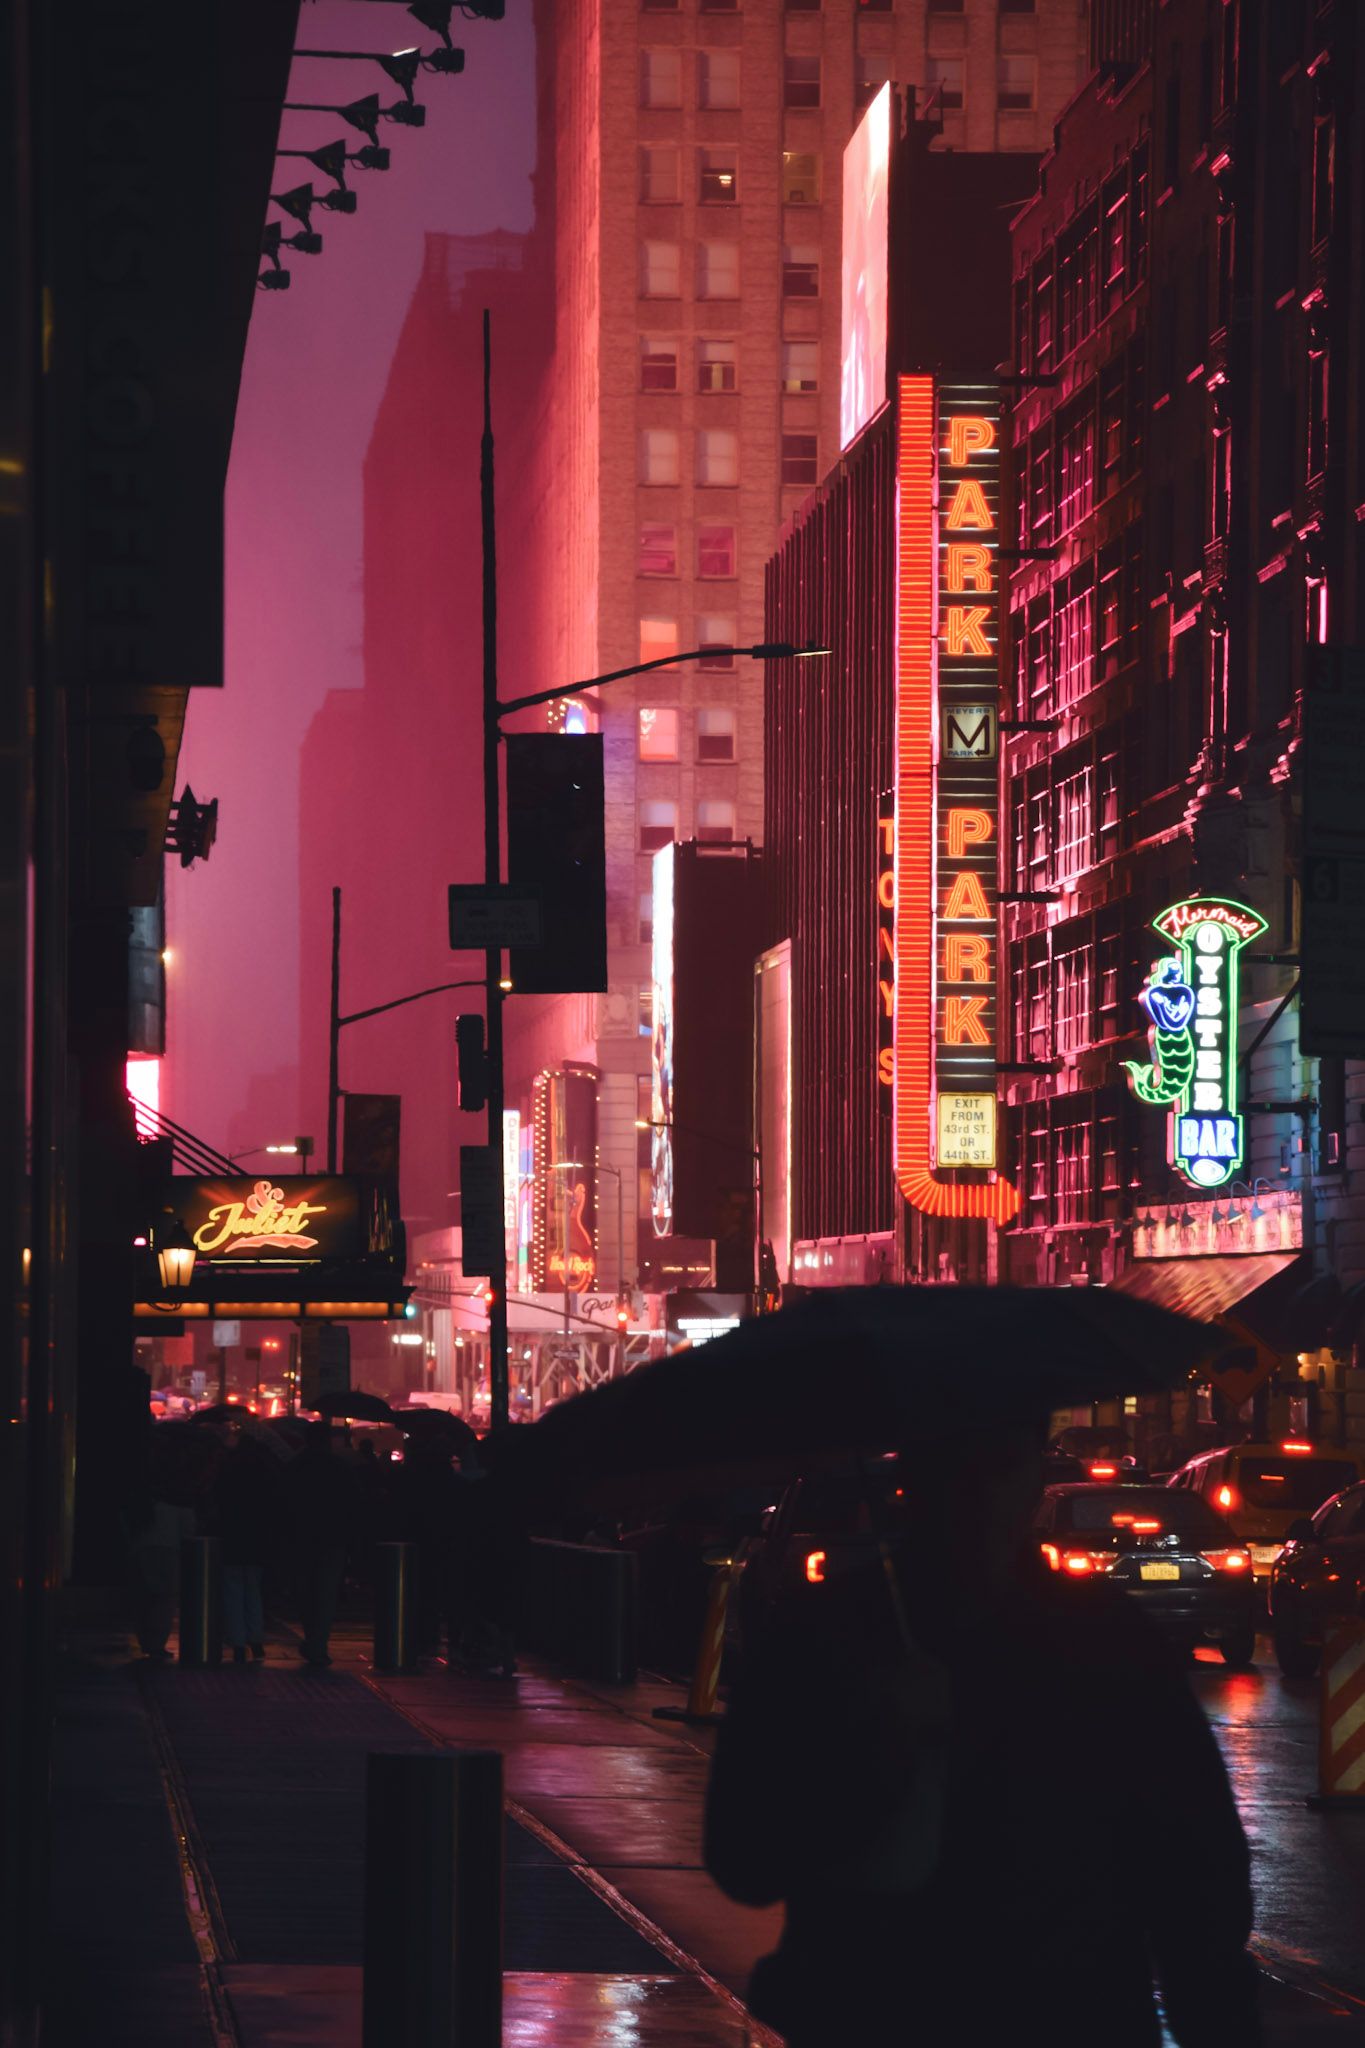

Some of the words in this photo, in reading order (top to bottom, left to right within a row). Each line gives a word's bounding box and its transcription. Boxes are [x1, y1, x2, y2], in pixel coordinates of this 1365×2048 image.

[945, 416, 994, 656] PARK
[946, 707, 990, 715] MEYERS
[943, 808, 993, 1045] PARK
[1160, 905, 1260, 938] Mermaid
[1194, 923, 1224, 1111] OYSTER
[951, 1111, 984, 1121] FROM
[954, 1099, 981, 1108] EXIT
[944, 1124, 969, 1134] 43rd
[973, 1124, 990, 1134] ST.
[960, 1137, 975, 1147] OR
[1180, 1119, 1238, 1157] BAR
[944, 1150, 969, 1160] 44th
[973, 1150, 990, 1160] ST.
[246, 1181, 285, 1215] &
[193, 1200, 327, 1251] Juliet
